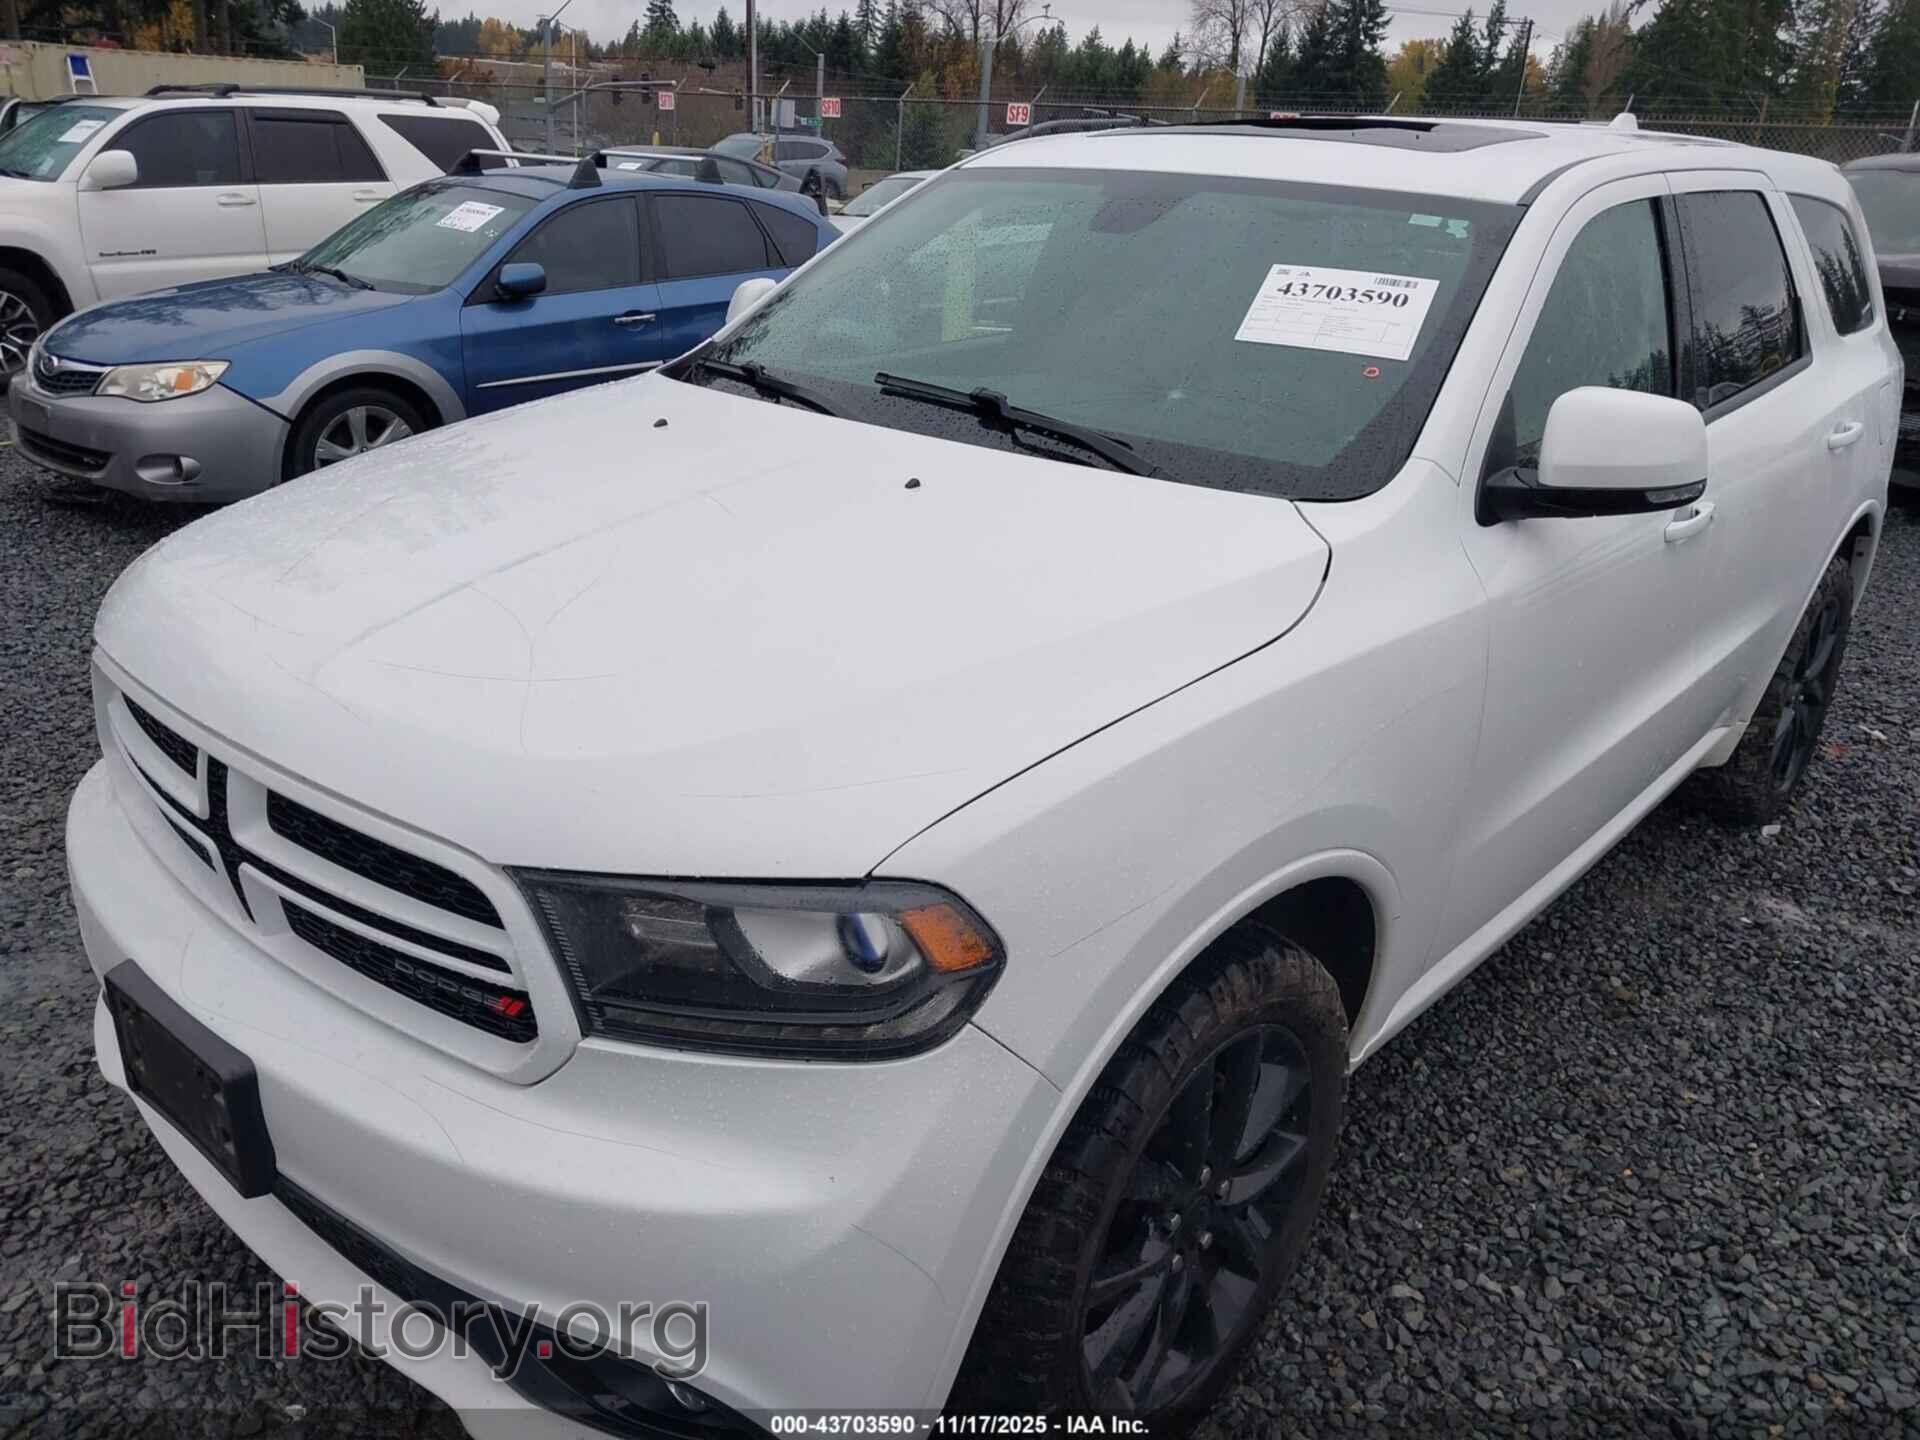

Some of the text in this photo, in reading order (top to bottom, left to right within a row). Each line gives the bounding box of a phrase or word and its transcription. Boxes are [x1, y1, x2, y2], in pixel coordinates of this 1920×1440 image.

[1008, 105, 1029, 122] SF9
[1277, 281, 1409, 308] 43703590
[394, 959, 506, 1011] DODGE
